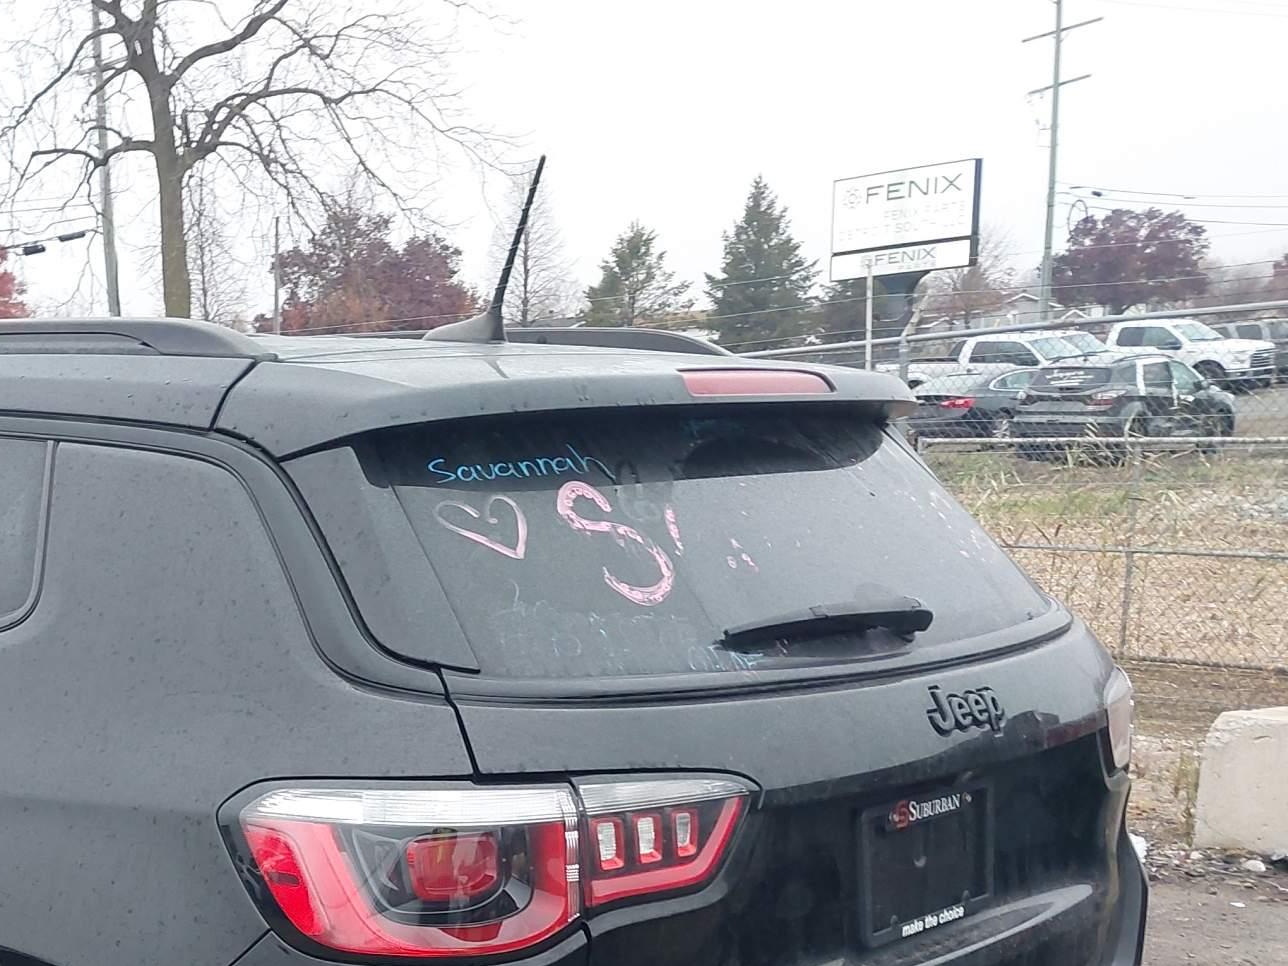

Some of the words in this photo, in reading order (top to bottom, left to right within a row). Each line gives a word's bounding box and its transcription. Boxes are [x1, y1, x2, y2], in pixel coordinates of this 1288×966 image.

[866, 173, 963, 204] FENIX
[874, 247, 937, 266] FENIX
[427, 443, 616, 484] Savannah
[926, 684, 1006, 737] Jeep
[902, 919, 924, 938] make
[925, 914, 938, 929] the
[939, 905, 965, 924] choice
